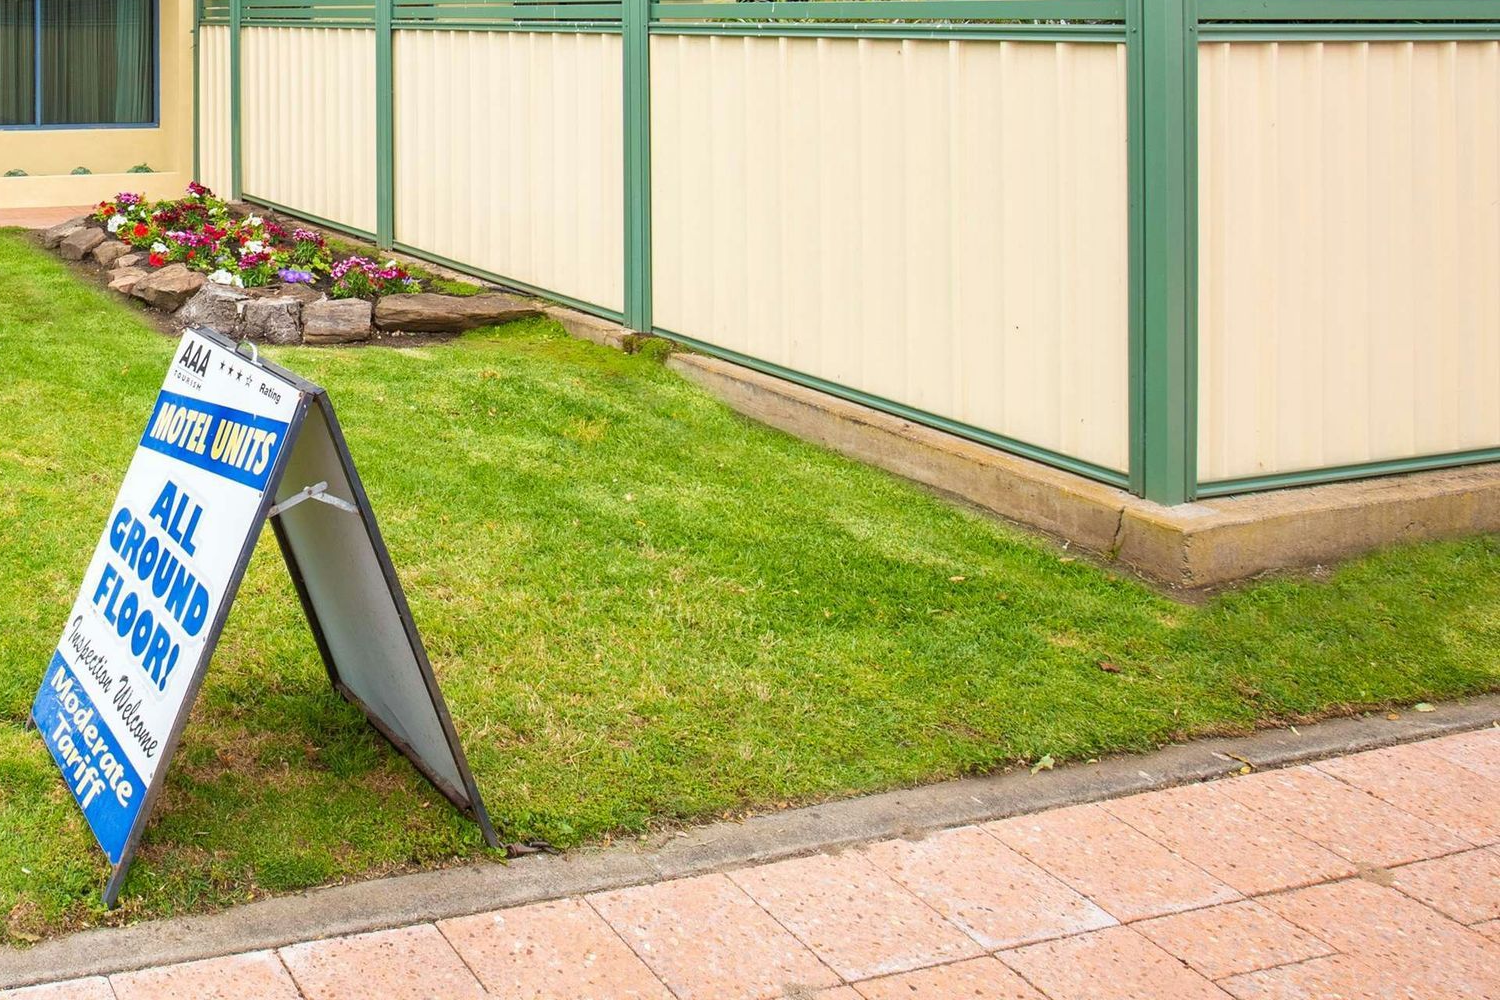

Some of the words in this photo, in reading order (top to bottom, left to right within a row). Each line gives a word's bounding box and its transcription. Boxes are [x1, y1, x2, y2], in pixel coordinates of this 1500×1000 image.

[174, 369, 202, 392] TOURISM
[179, 340, 212, 377] AAA
[259, 382, 282, 405] Rating
[150, 402, 213, 455] MOTEL
[210, 418, 278, 475] UNITS
[149, 480, 203, 557] ALL
[109, 507, 209, 637] GROUND
[92, 562, 180, 692] FLOOR!
[68, 615, 113, 693] Inspection
[113, 675, 159, 758] Welcome
[51, 665, 133, 808] Moderate
[52, 712, 106, 809] Tariff
